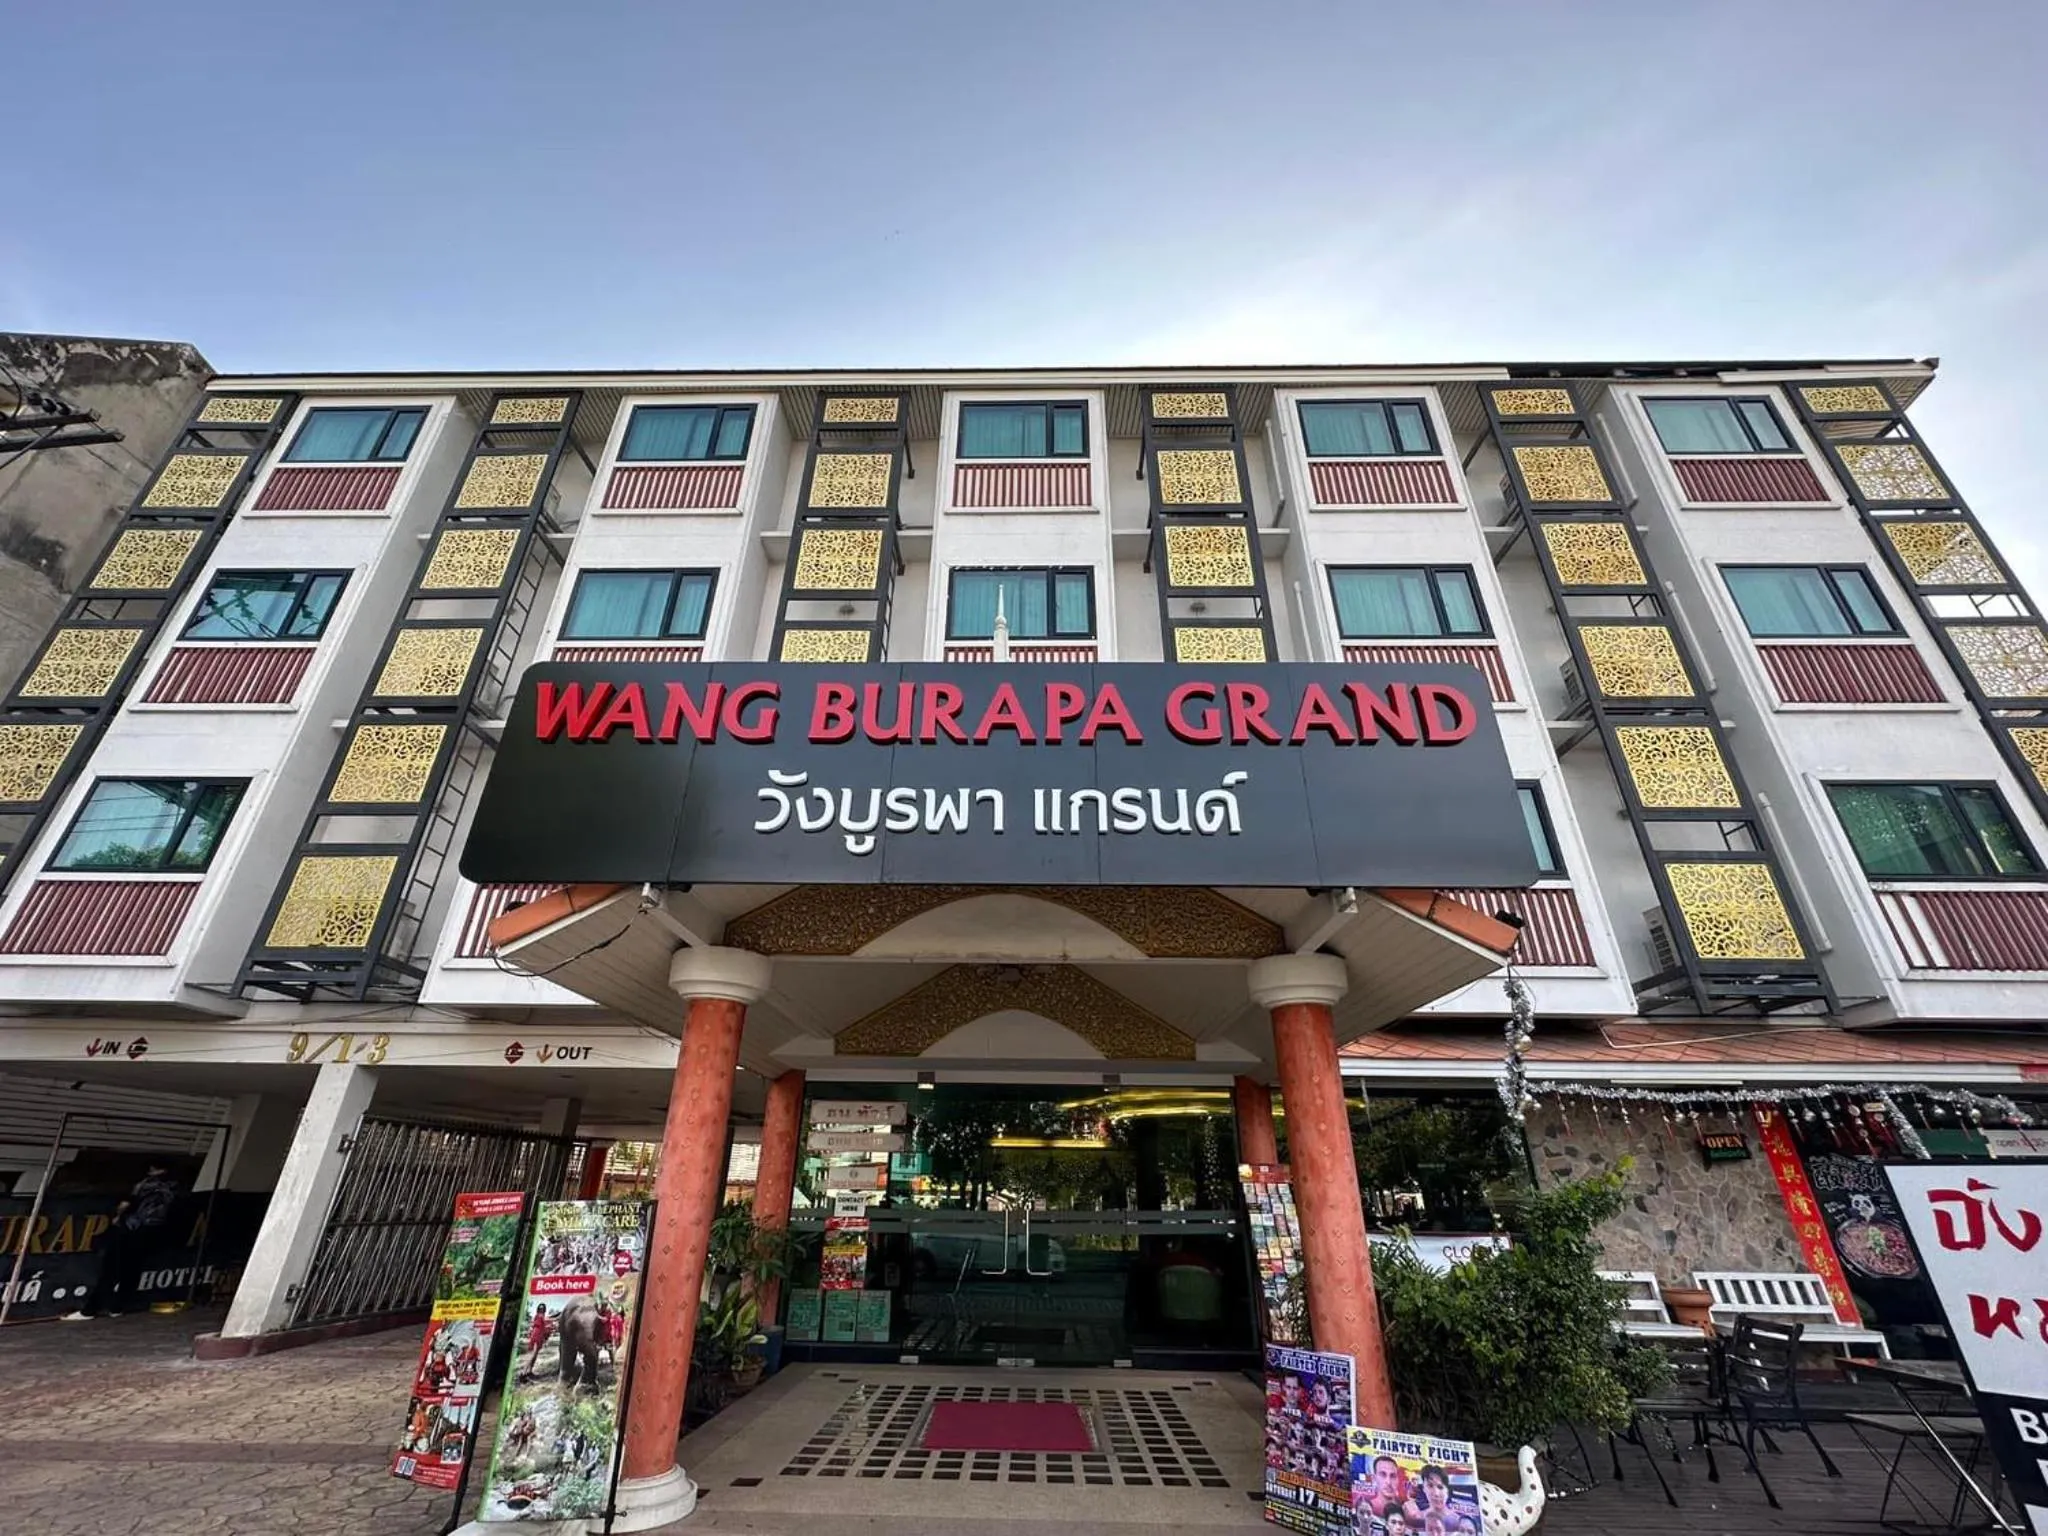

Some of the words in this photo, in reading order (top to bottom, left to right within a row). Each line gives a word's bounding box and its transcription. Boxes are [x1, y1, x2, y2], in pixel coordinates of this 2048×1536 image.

[534, 681, 781, 745] WANG
[808, 681, 1144, 745] BURAPA
[1165, 681, 1477, 747] GRAND
[753, 769, 1004, 856] วังบูรพา
[1033, 769, 1248, 834] แกรนด์
[102, 1040, 121, 1055] IN
[556, 1045, 593, 1060] OUT
[1706, 1135, 1744, 1148] OPEN
[837, 1196, 865, 1204] CONTACT
[842, 1204, 859, 1212] HERE
[137, 1264, 215, 1292] HOTEL
[536, 1280, 564, 1291] Book
[566, 1278, 590, 1290] here
[1280, 1354, 1316, 1374] FAIRTEX
[1317, 1361, 1350, 1378] FIGHT
[1372, 1438, 1422, 1456] FAIRTEX
[1428, 1445, 1470, 1463] FIGHT
[1298, 1487, 1315, 1507] 17
[1317, 1499, 1335, 1513] JUNE
